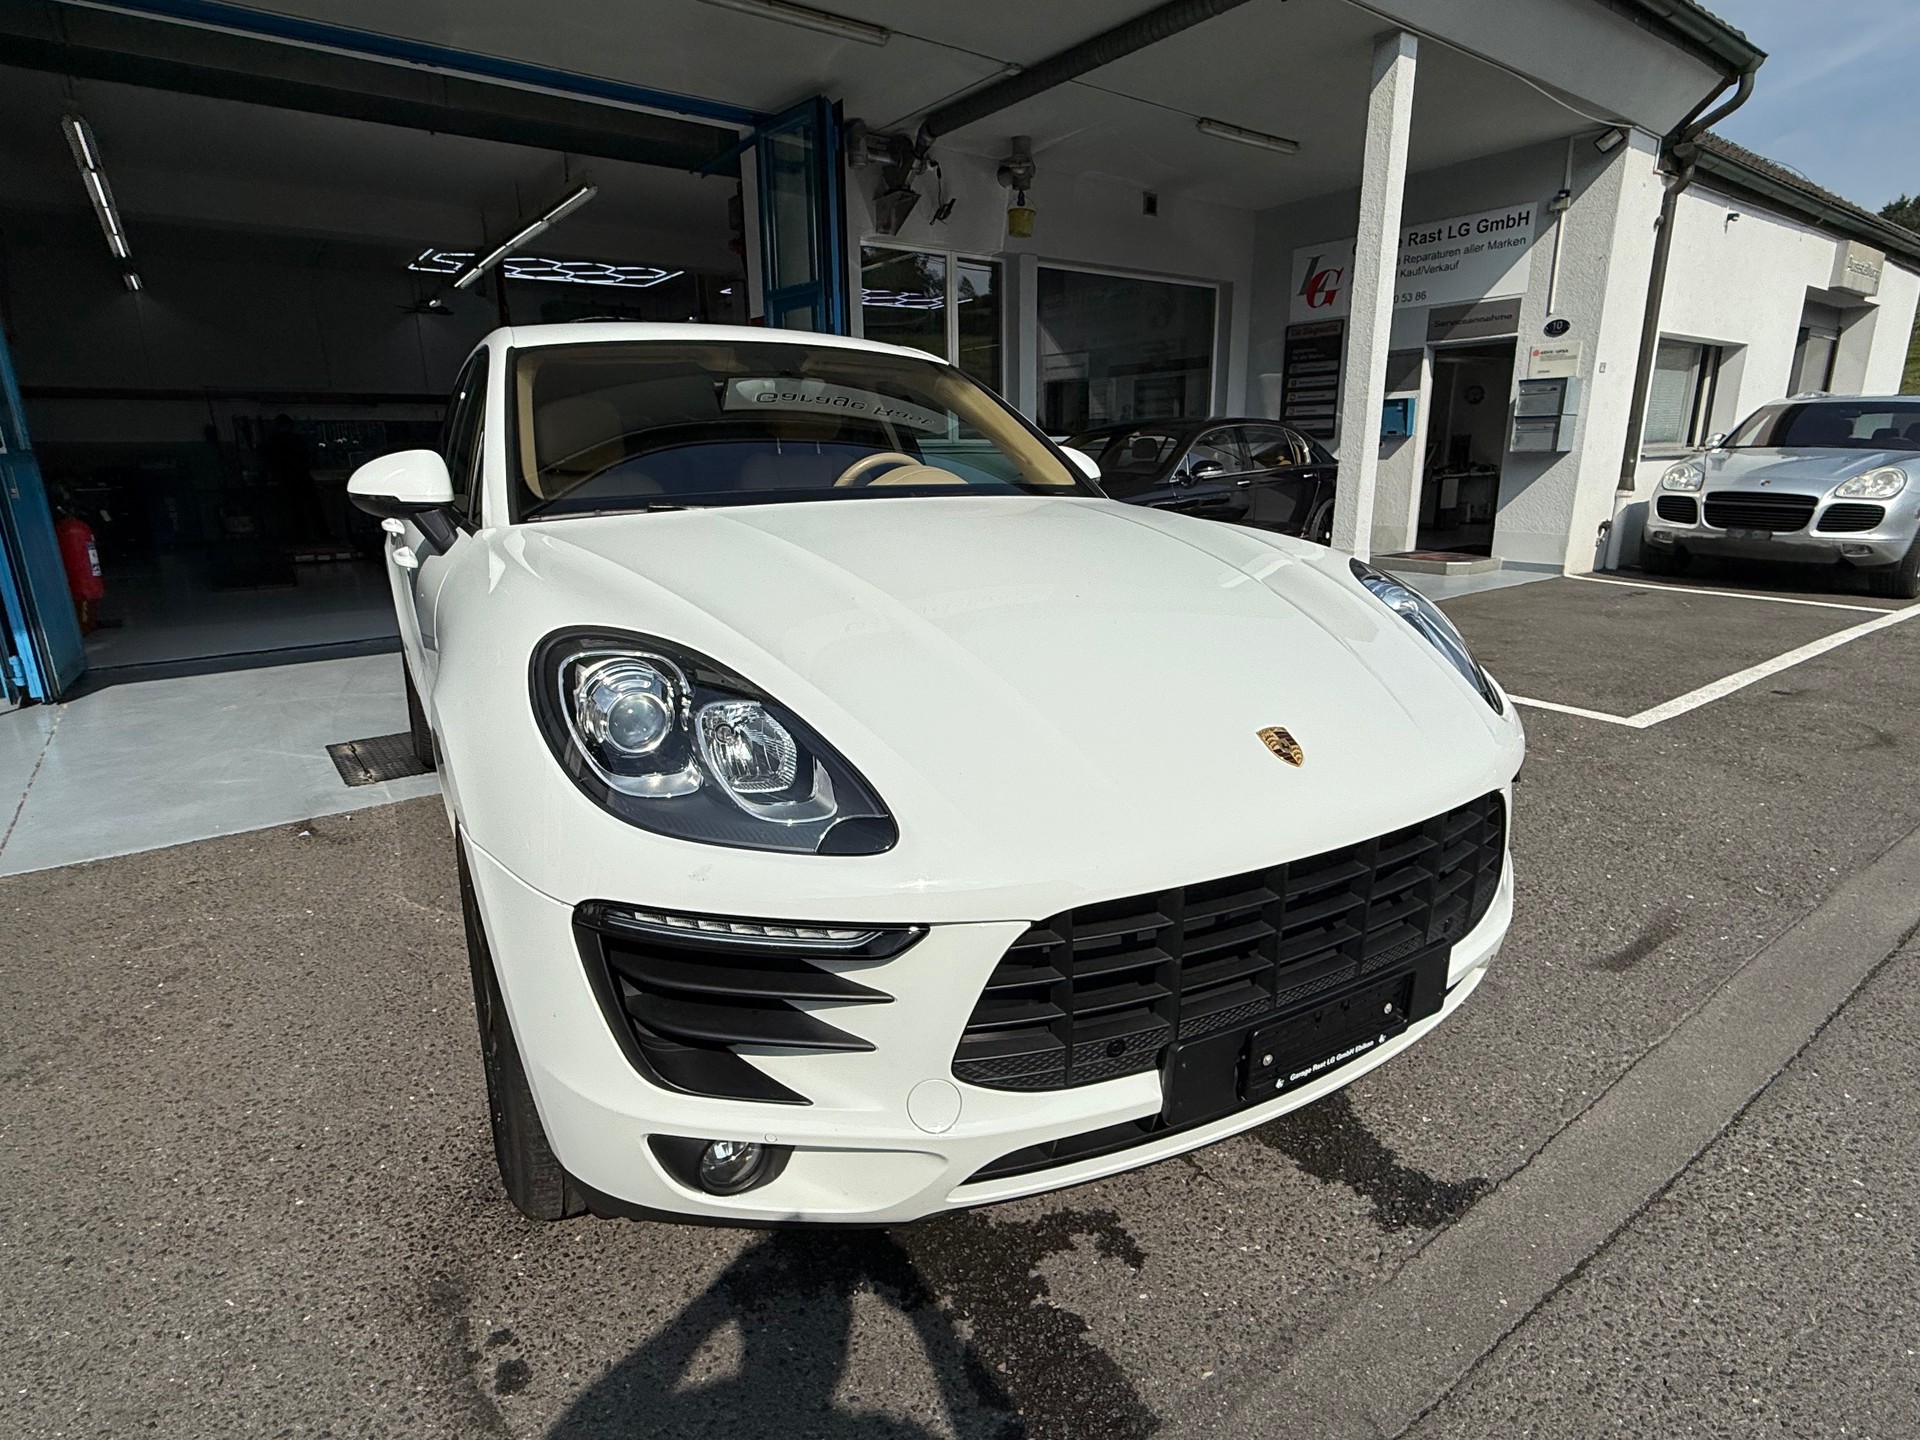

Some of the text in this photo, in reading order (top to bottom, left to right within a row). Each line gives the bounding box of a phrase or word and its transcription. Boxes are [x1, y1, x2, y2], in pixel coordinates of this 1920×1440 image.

[1408, 228, 1442, 247] Rast
[1447, 222, 1470, 240] LG
[1476, 210, 1531, 234] GmbH
[1403, 247, 1461, 267] Reparaturen
[1463, 243, 1485, 255] aller
[1487, 236, 1527, 251] Marken
[1399, 260, 1460, 279] Kauf/Verkauf
[1401, 294, 1413, 303] 53
[1414, 291, 1428, 302] 86
[1433, 314, 1514, 328] Serviceannahme
[1552, 321, 1564, 331] 10
[1290, 1067, 1312, 1081] Garage
[1313, 1061, 1326, 1072] Rast
[1326, 1056, 1336, 1065] LG
[1336, 1048, 1355, 1061] GmbH
